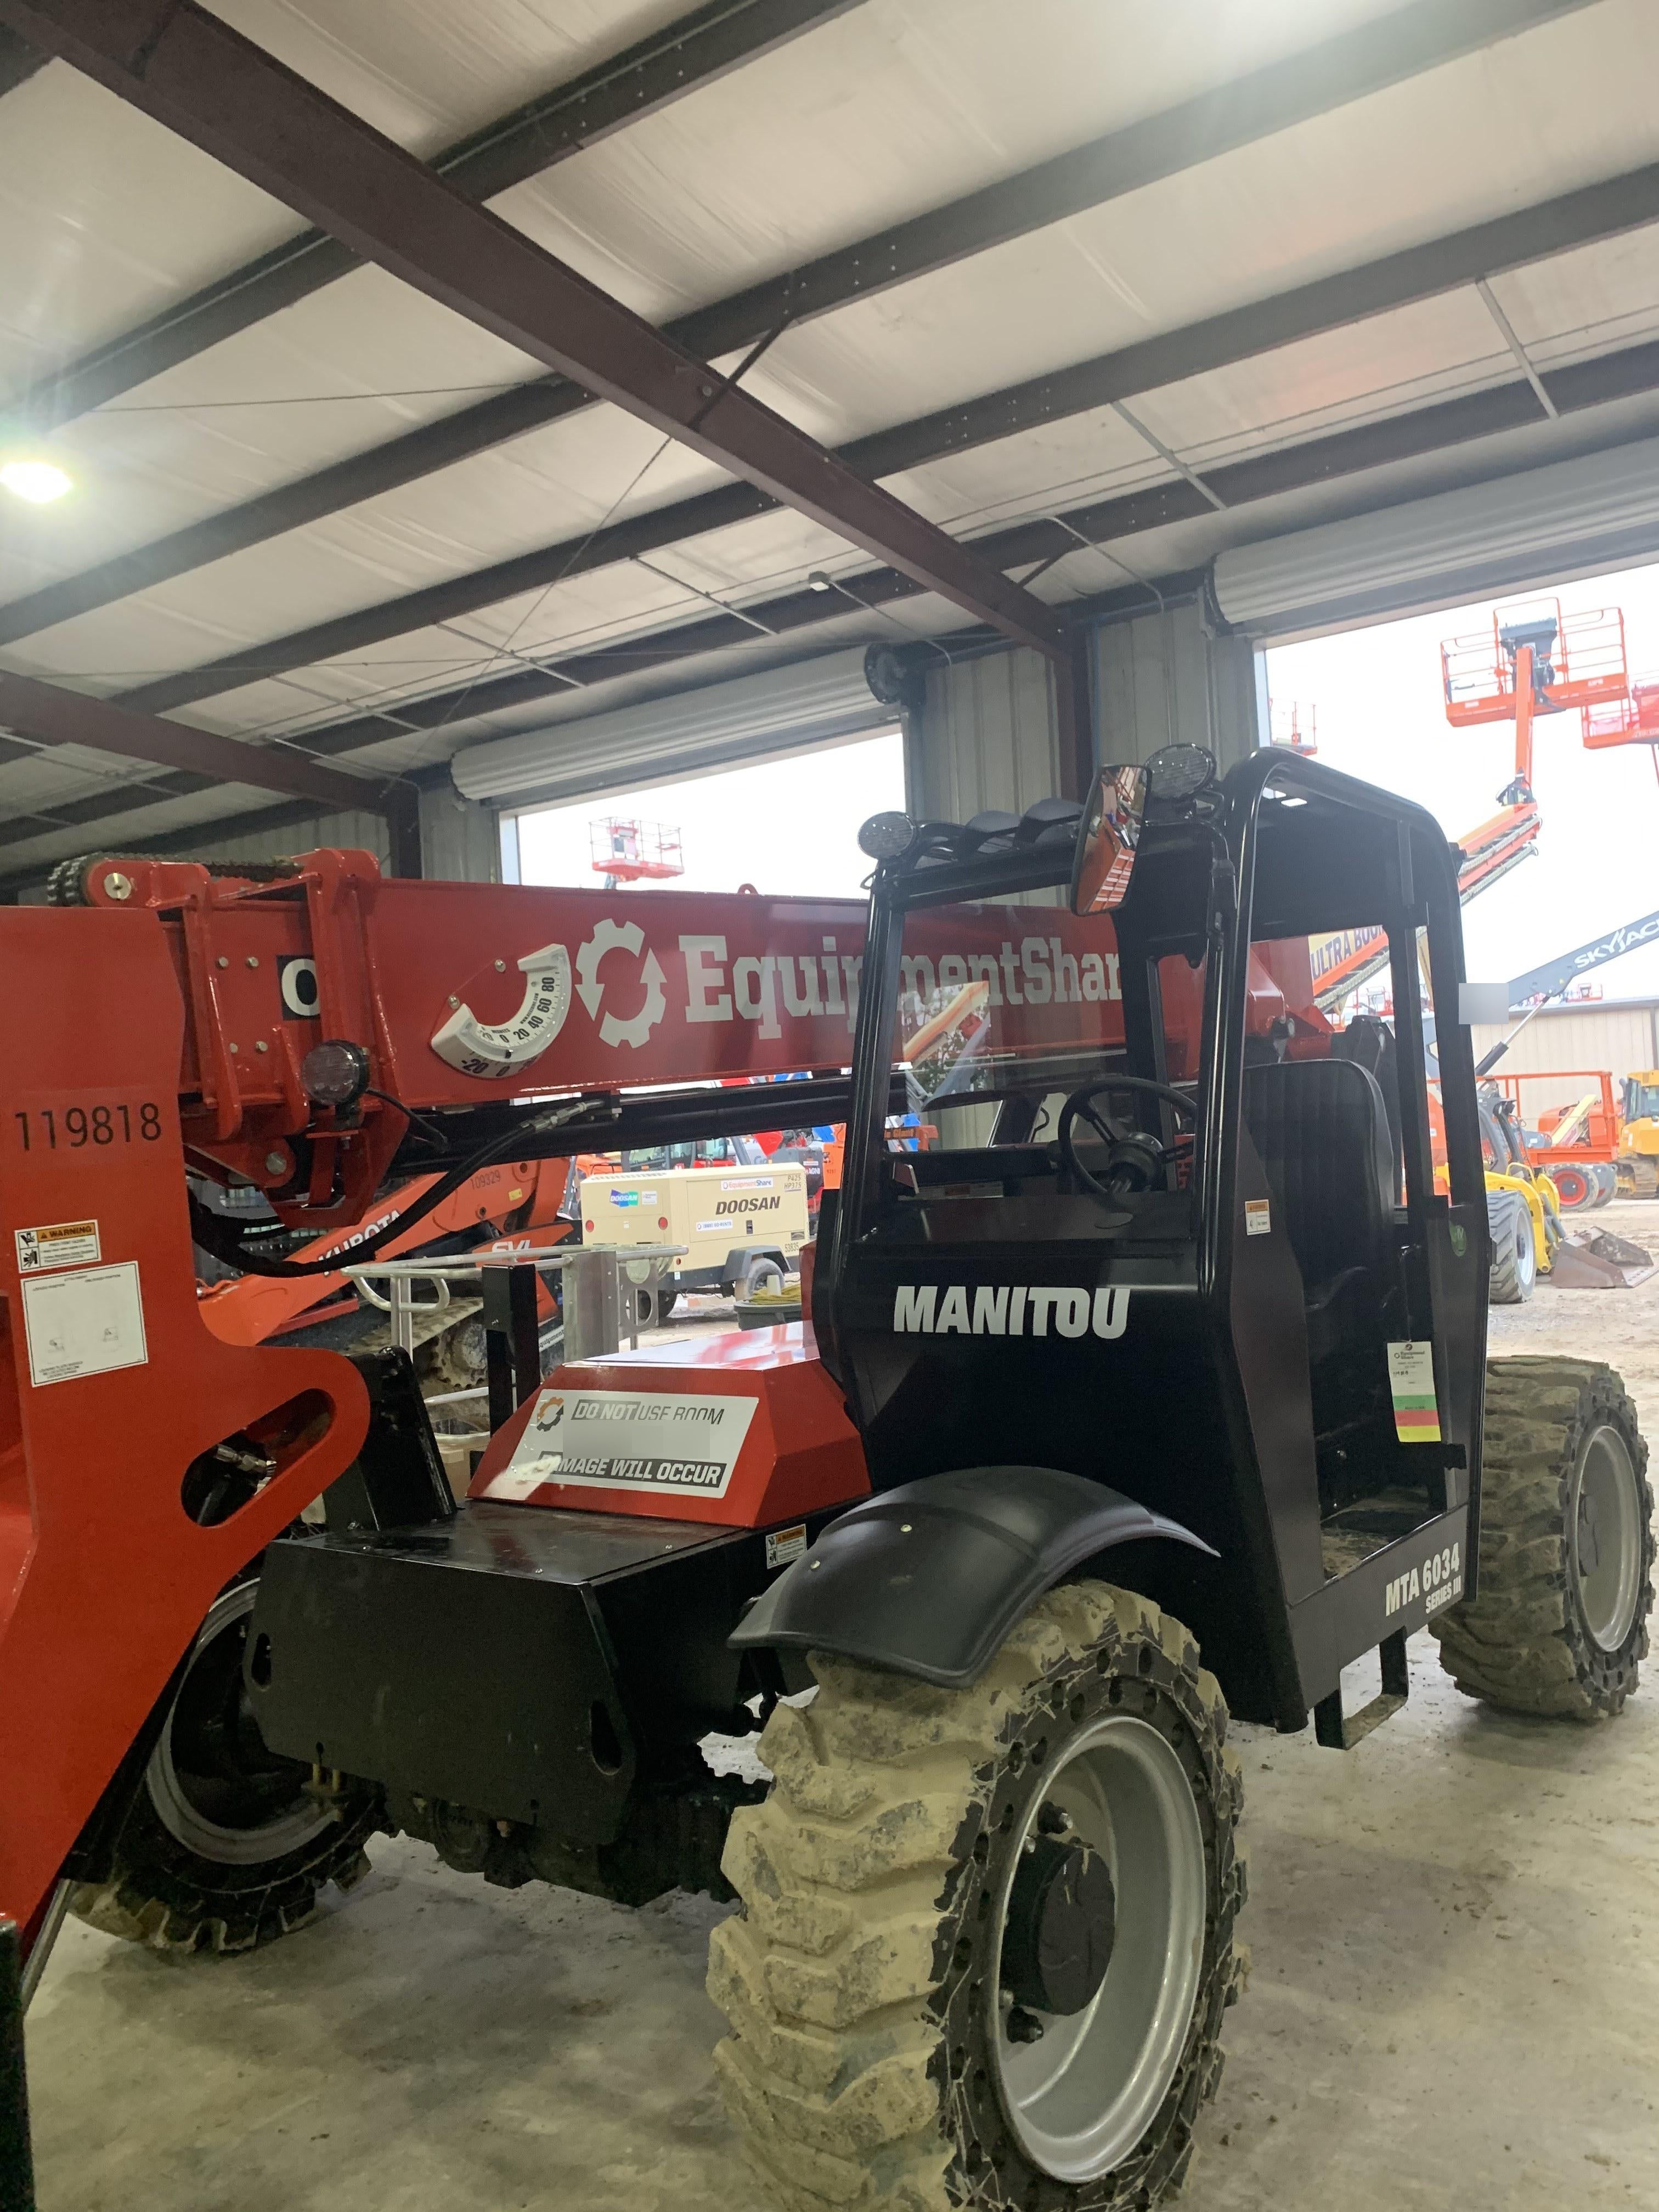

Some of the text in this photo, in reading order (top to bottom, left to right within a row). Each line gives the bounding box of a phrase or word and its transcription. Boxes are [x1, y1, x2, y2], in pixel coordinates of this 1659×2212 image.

[1574, 918, 1659, 968] SKYJAC
[1311, 926, 1383, 980] ULTRA BOO
[541, 977, 555, 992] 80
[678, 934, 1122, 1040] EquimentShar
[537, 997, 552, 1013] 60
[527, 1015, 544, 1029] 40
[499, 1034, 510, 1043] 0
[513, 1028, 530, 1040] 20
[14, 1102, 162, 1152] 119818
[728, 1179, 772, 1189] EquipmentShare
[784, 1181, 802, 1190] HP375
[715, 1195, 781, 1215] DOOSAN
[49, 1225, 92, 1238] WARNING
[894, 1285, 1131, 1339] MANITOU
[539, 1329, 565, 1348] quipment
[575, 1402, 600, 1420] DO
[599, 1403, 637, 1420] NOT
[543, 1454, 722, 1485] MAGE WILL OCCUR
[1386, 1542, 1460, 1617] MTA 6034
[1425, 1575, 1462, 1614] SERIES III
